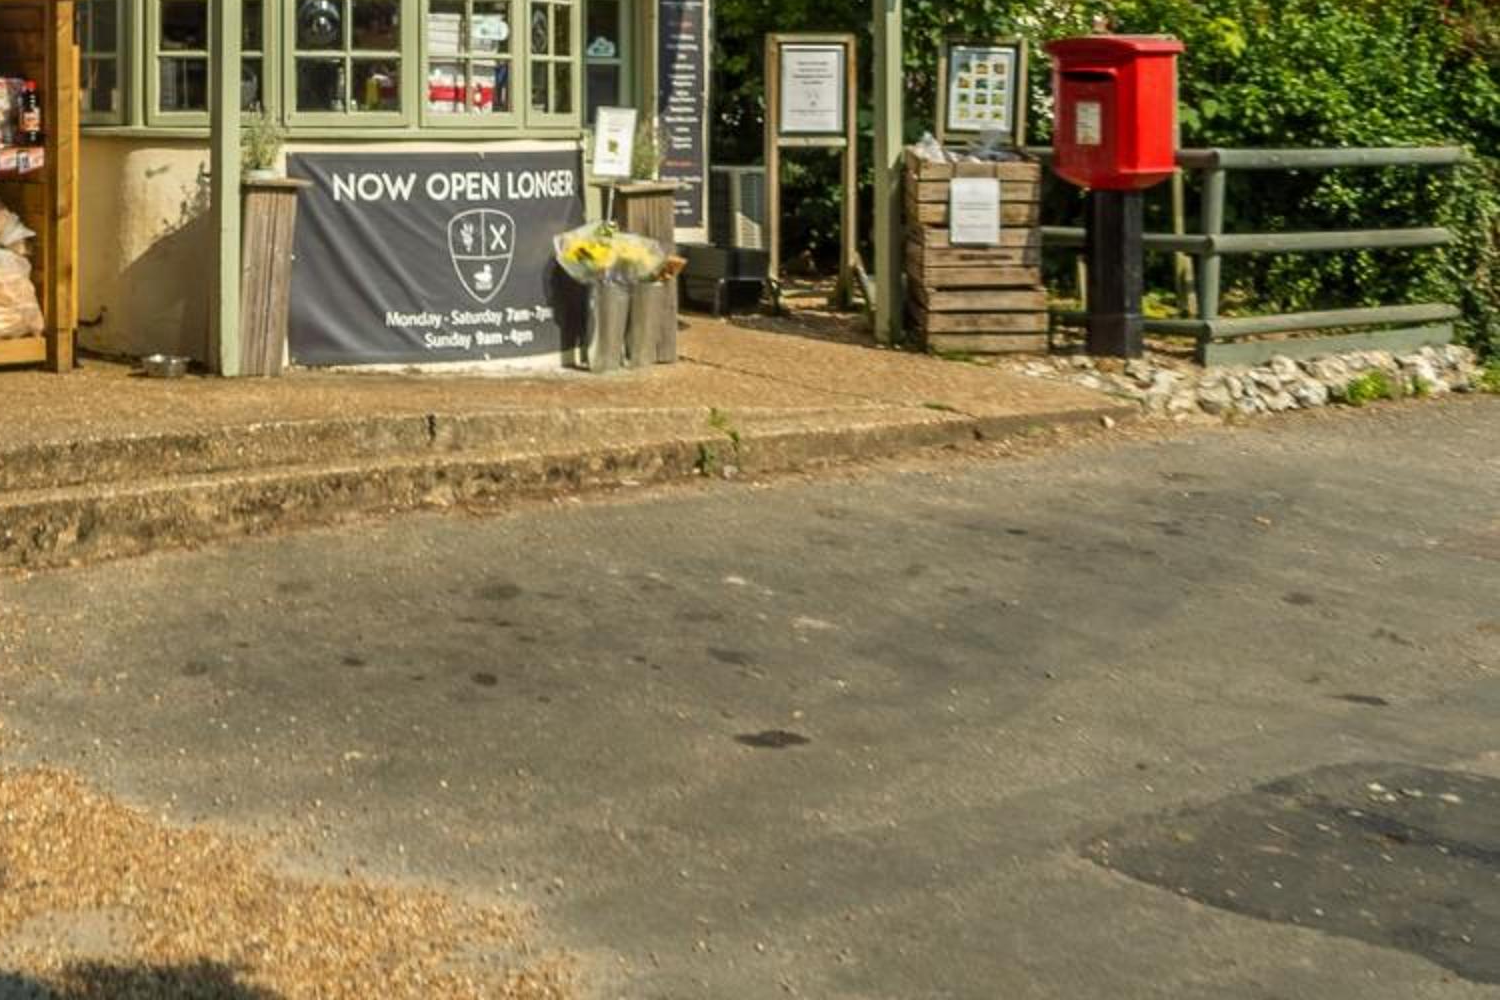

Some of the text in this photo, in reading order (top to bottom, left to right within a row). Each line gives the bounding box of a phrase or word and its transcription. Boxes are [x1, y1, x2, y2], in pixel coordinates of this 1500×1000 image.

[332, 169, 575, 202] NOW OPEN LONGER
[385, 310, 442, 329] Monday
[451, 308, 503, 327] Saturday
[423, 331, 472, 350] Sunday
